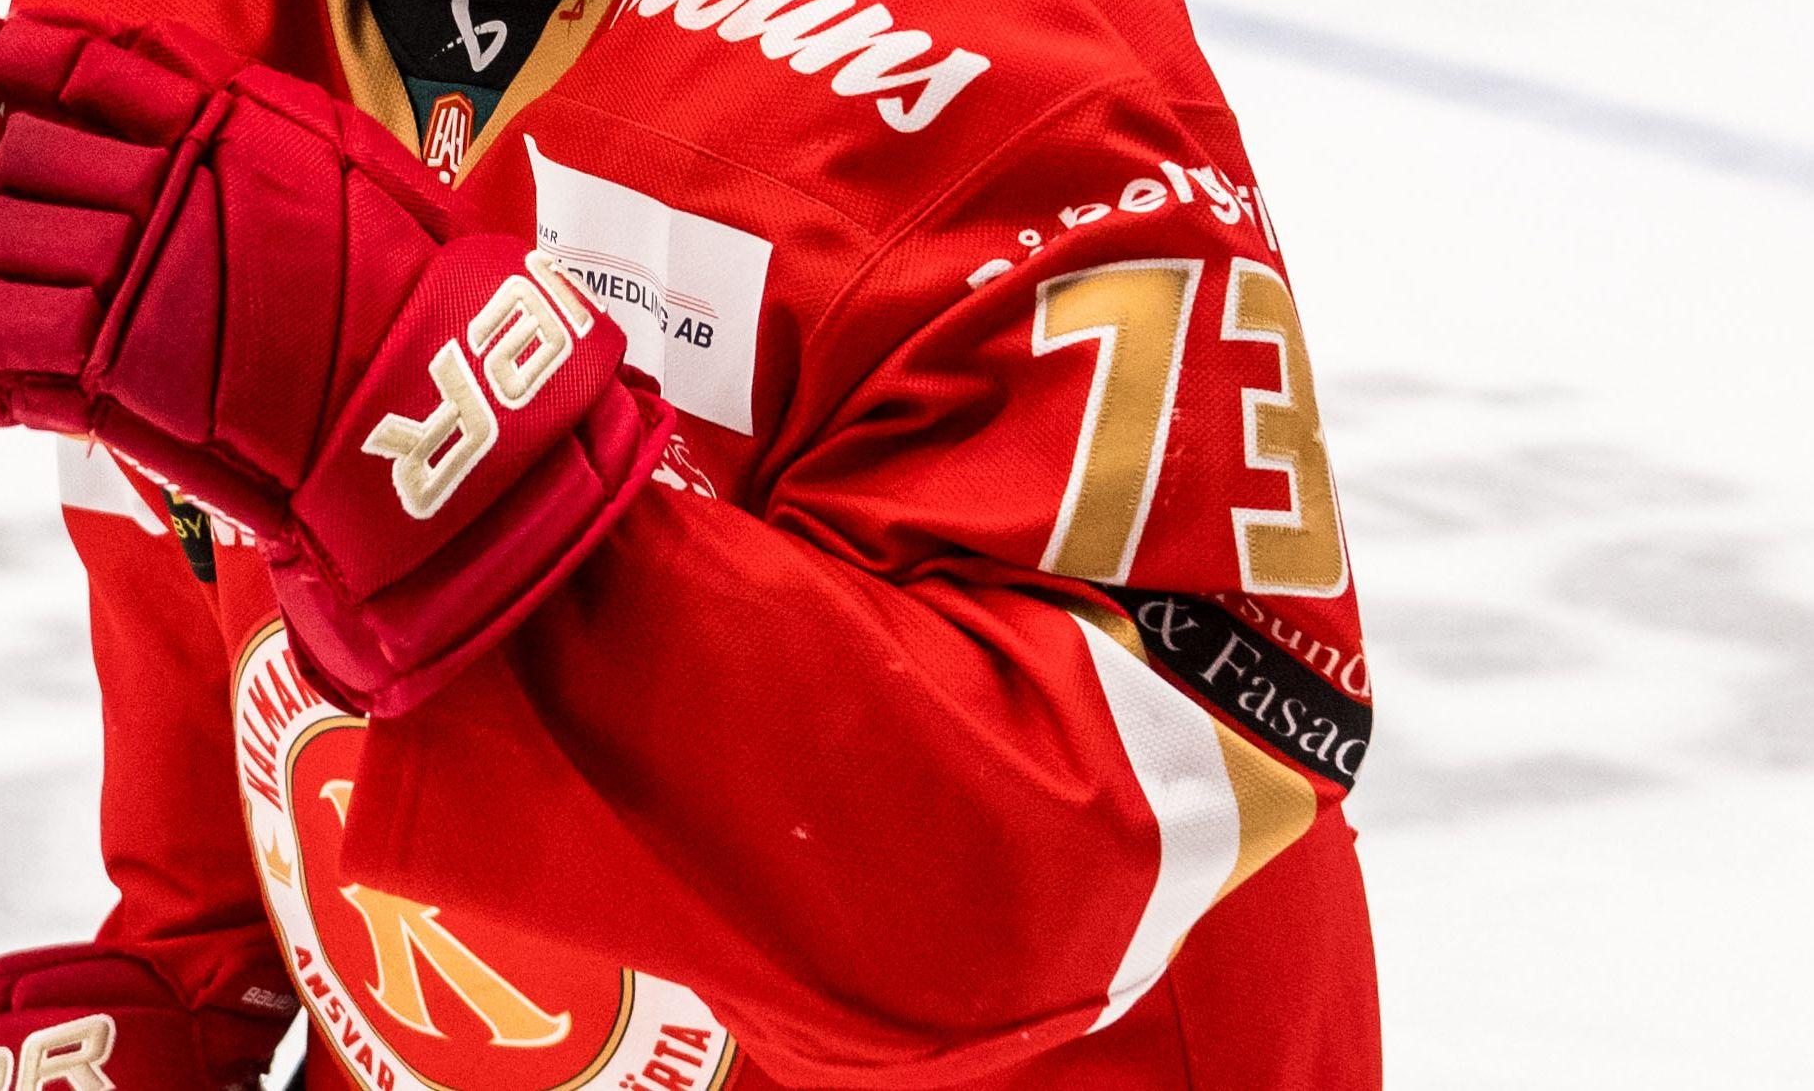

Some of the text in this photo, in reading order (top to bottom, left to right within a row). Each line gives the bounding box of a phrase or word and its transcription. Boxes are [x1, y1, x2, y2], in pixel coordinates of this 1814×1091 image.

[557, 258, 714, 349] MEDLING AB
[1032, 256, 1349, 599] 73
[1137, 597, 1200, 652] &
[242, 649, 323, 815] KALMAR
